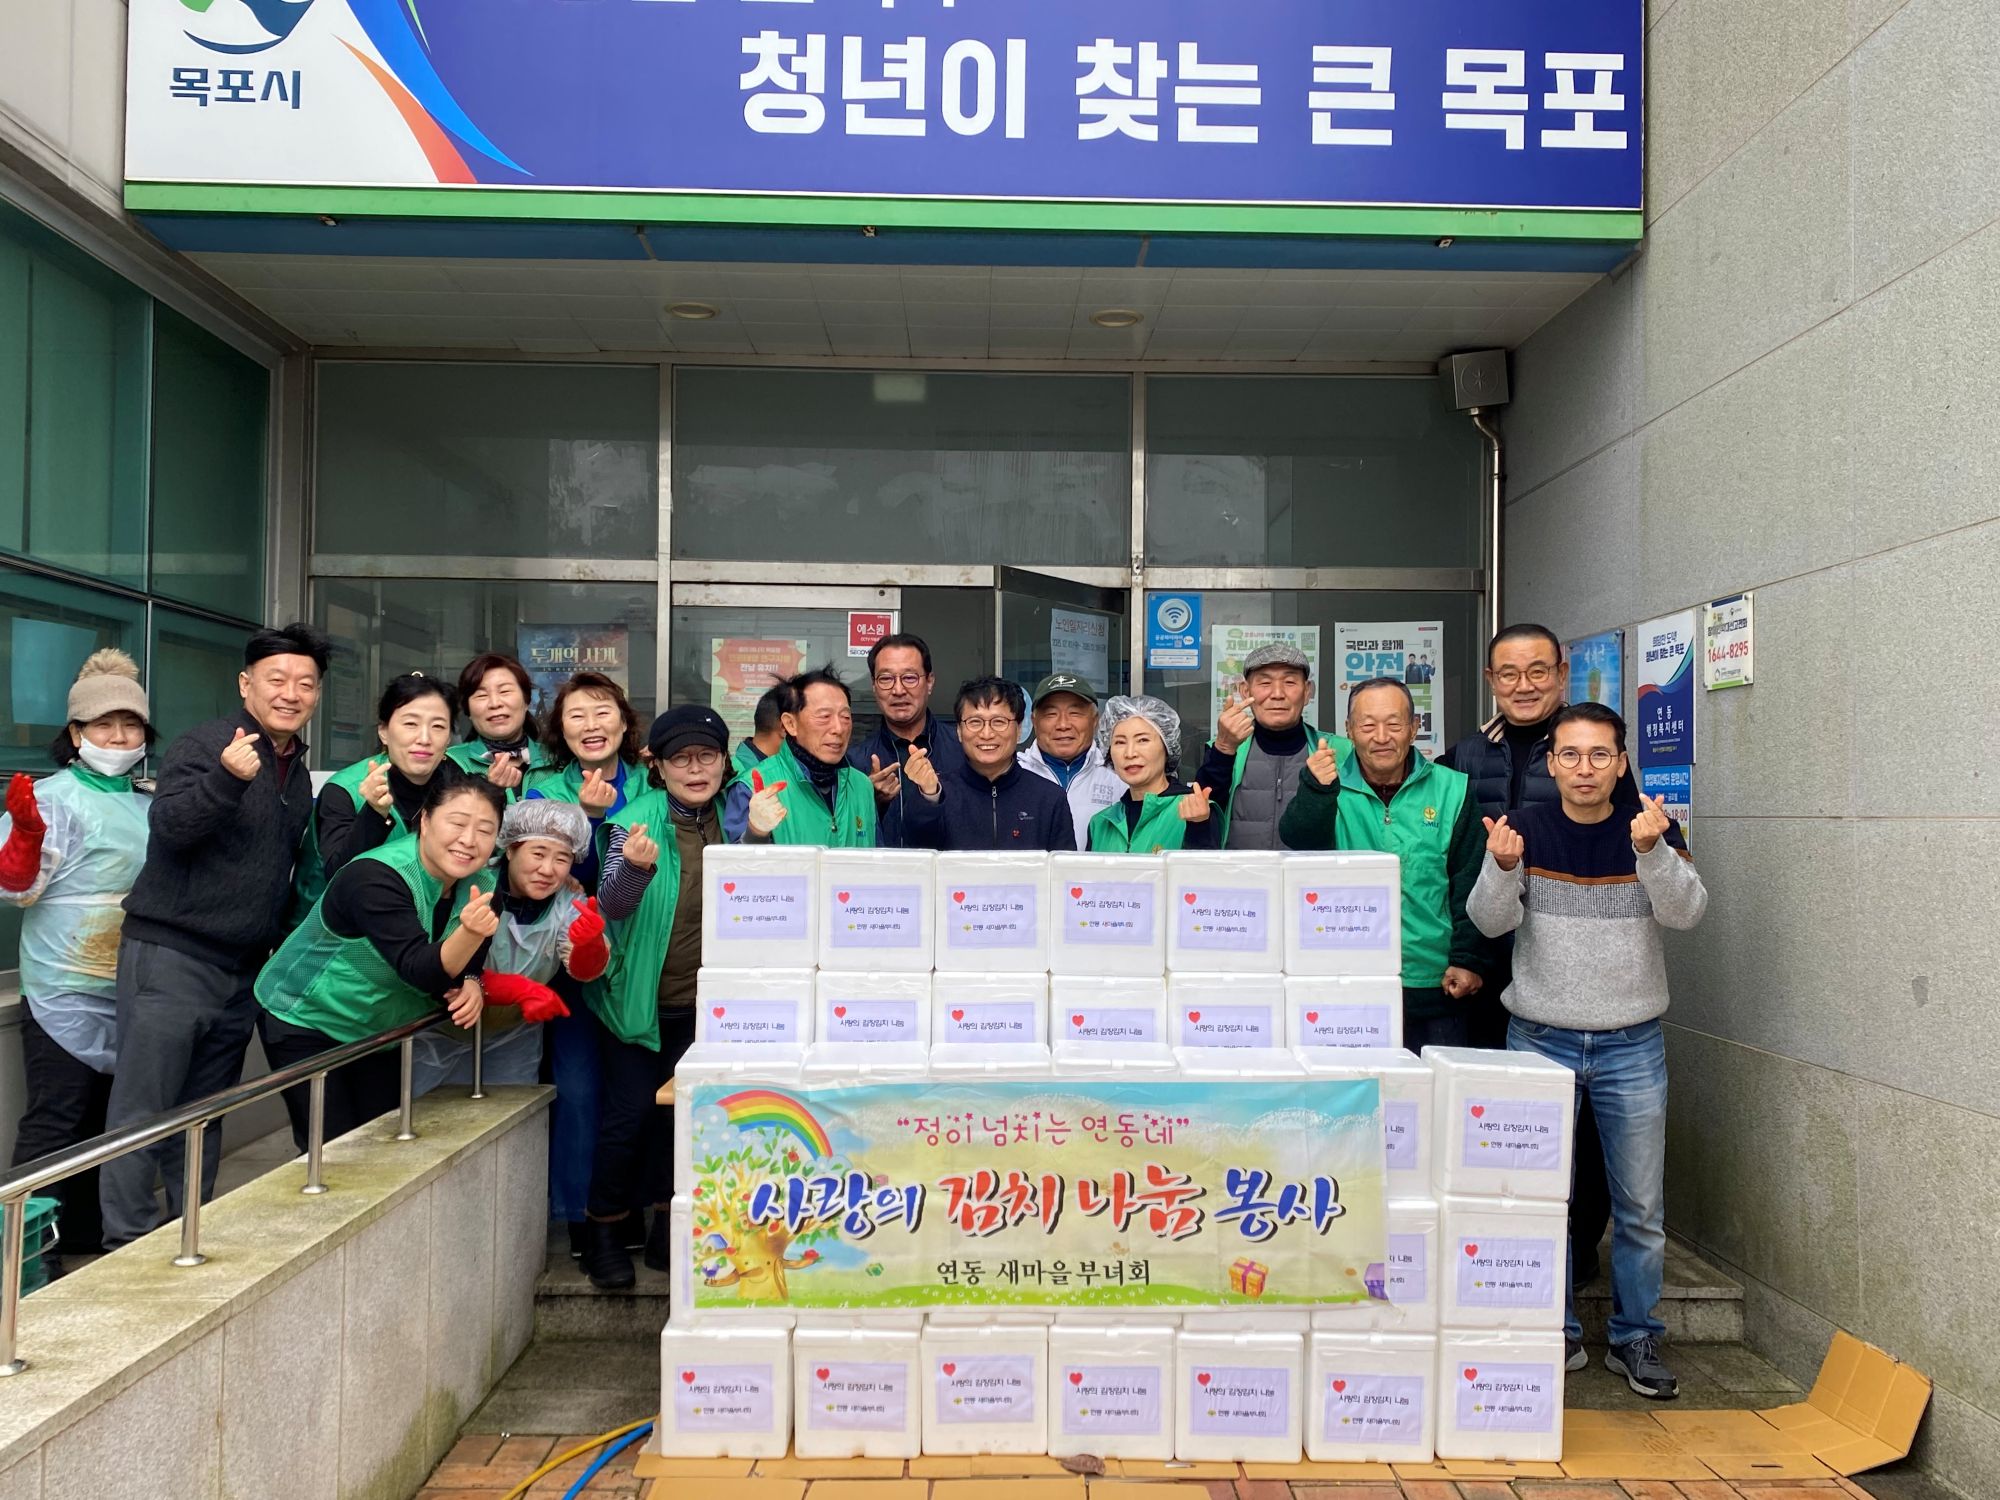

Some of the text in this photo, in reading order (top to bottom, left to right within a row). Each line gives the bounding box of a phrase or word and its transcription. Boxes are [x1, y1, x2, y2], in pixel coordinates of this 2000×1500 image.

[168, 67, 301, 110] 목포시
[739, 30, 1628, 150] 청년이 찾는 큰 목포
[856, 623, 885, 635] 에스원
[1345, 639, 1404, 651] 국민과 함께
[530, 646, 579, 664] 두개의
[1707, 640, 1749, 663] 1644-8295
[1345, 652, 1404, 681] 안전
[1646, 720, 1684, 738] 행정복지센터
[729, 893, 750, 904] 사랑의
[780, 895, 795, 903] 나눔
[1076, 899, 1097, 909] 사랑의
[1127, 901, 1141, 910] 나눔
[844, 906, 865, 915] 사랑의
[895, 906, 910, 915] 나눔
[959, 903, 980, 913] 사랑의
[1010, 903, 1024, 911] 나눔
[1191, 908, 1212, 917] 사랑의
[1242, 909, 1257, 918] 나눔
[1312, 905, 1333, 914] 사랑의
[1363, 905, 1378, 914] 나눔
[719, 1022, 740, 1031] 사랑의
[771, 1022, 786, 1031] 나눔
[839, 1019, 860, 1028] 사랑의
[890, 1019, 905, 1028] 나눔
[957, 1021, 978, 1031] 사랑의
[1008, 1021, 1023, 1030] 나눔
[1194, 1024, 1215, 1033] 사랑의
[1245, 1024, 1260, 1033] 나눔
[1077, 1027, 1098, 1036] 사랑의
[1128, 1027, 1143, 1036] 나눔
[1314, 1026, 1335, 1036] 사랑의
[1365, 1026, 1380, 1035] 나눔
[982, 1112, 1072, 1147] 넘치는
[1478, 1122, 1501, 1132] 사랑의
[1534, 1124, 1549, 1134] 나눔
[749, 1162, 1347, 1243] 사랑의 김치 나눔 봉사
[1470, 1257, 1493, 1268] 사랑의
[1526, 1259, 1541, 1269] 나눔
[936, 1259, 1151, 1287] 연동 새마을부녀회
[822, 1381, 845, 1391] 사랑의
[878, 1383, 894, 1393] 나눔
[950, 1378, 973, 1388] 사랑의
[1006, 1377, 1022, 1387] 나눔
[1470, 1382, 1493, 1392] 사랑의
[1526, 1384, 1541, 1393] 나눔
[688, 1384, 711, 1396] 사랑의
[744, 1384, 760, 1394] 나눔
[1075, 1386, 1098, 1396] 사랑의
[1131, 1386, 1147, 1396] 나눔
[1203, 1386, 1226, 1397] 사랑의
[1259, 1388, 1275, 1398] 나눔
[1338, 1394, 1361, 1405] 사랑의
[1394, 1396, 1410, 1406] 나눔
